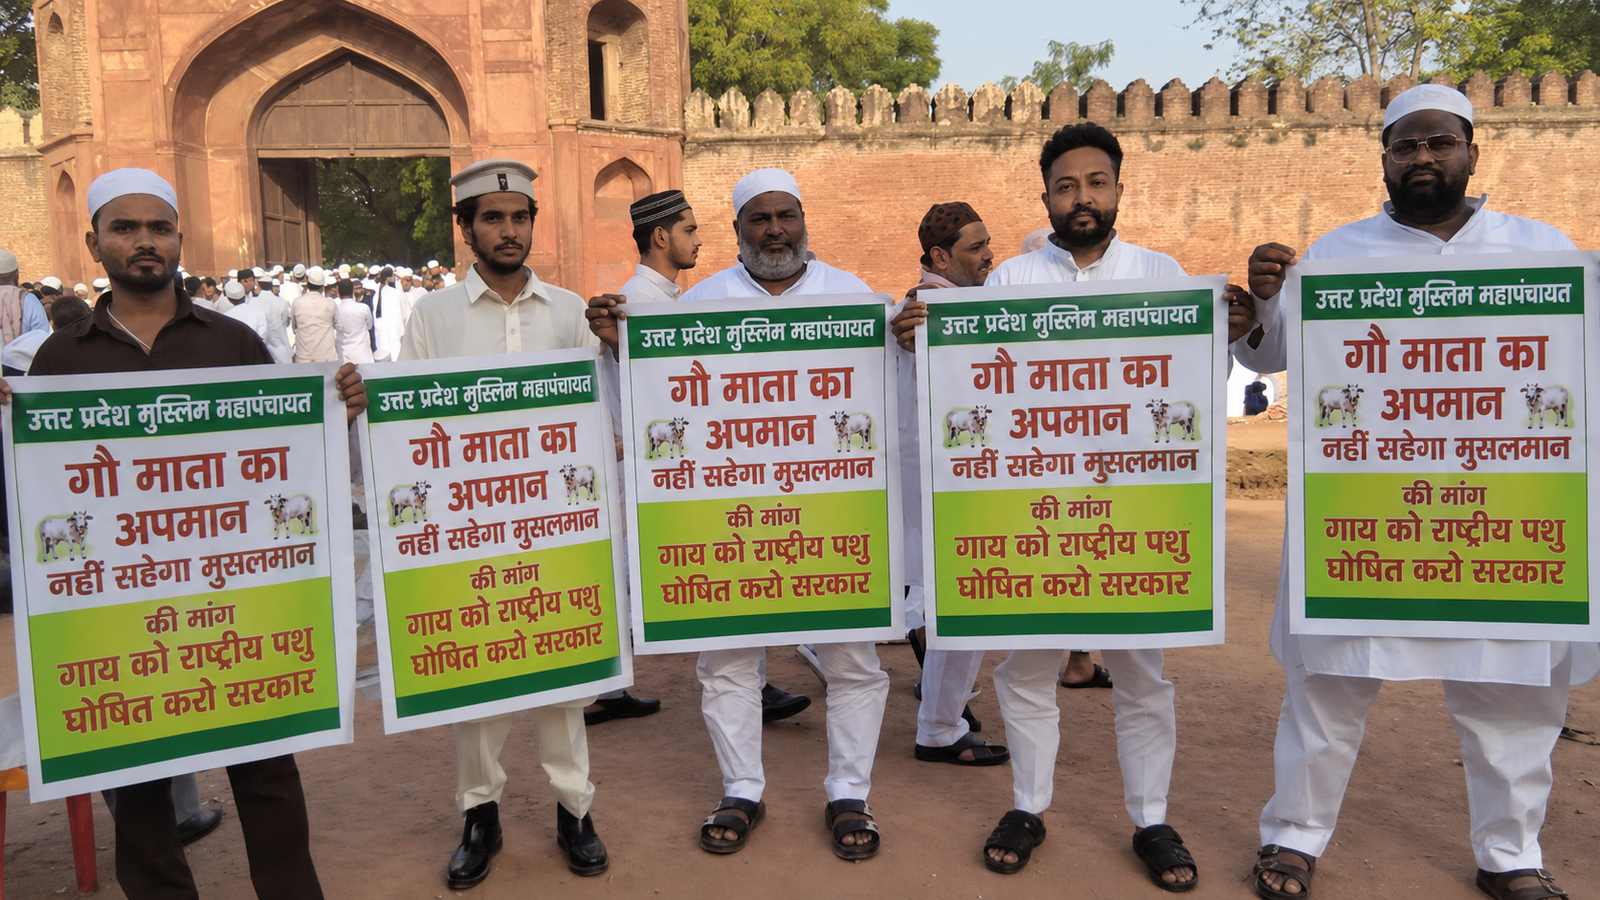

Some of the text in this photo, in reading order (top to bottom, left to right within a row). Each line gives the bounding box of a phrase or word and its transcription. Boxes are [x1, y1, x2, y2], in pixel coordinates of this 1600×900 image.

[1315, 278, 1572, 315] उत्तर प्रदेश मुस्लिम महापंचायत
[640, 315, 875, 351] उत्तर प्रदेश मुस्लिम महापंचायत
[941, 300, 1200, 339] उत्तर प्रदेश मुस्लिम महापंचायत
[1343, 323, 1549, 373] गौ माता का
[668, 360, 855, 407] गौ माता का
[971, 347, 1172, 394] गौ माता का
[26, 389, 312, 434] उत्तर प्रदेश मुस्लिम महापंचायत
[378, 372, 592, 412] उत्तर प्रदेश मुस्लिम महापंचायत
[1380, 386, 1506, 422] अपमान
[705, 415, 817, 450] अपमान
[1009, 403, 1131, 439] अपमान
[409, 421, 578, 469] गौ माता का
[950, 446, 1200, 483] नहीं सहेगा मुसलमान
[1321, 428, 1572, 471] नहीं सहेगा मुसलमान
[65, 444, 290, 498] गौ माता का
[448, 470, 549, 512] अपमान
[651, 457, 875, 493] नहीं सहेगा मुसलमान
[1030, 495, 1113, 520] की मांग
[1401, 479, 1488, 506] की मांग
[115, 501, 249, 547] अपमान
[396, 508, 600, 556] नहीं सहेगा मुसलमान
[725, 502, 802, 528] की मांग
[1323, 510, 1566, 553] गाय को राष्ट्रीय पशु
[657, 530, 871, 567] गाय को राष्ट्रीय पशु
[954, 523, 1191, 564] गाय को राष्ट्रीय पशु
[46, 542, 316, 597] नहीं सहेगा मुसलमान
[470, 560, 540, 590] की मांग
[660, 569, 872, 605] घोषित करो सरकार
[956, 564, 1192, 600] घोषित करो सरकार
[1325, 549, 1566, 585] घोषित करो सरकार
[144, 600, 236, 634] की मांग
[406, 583, 601, 637] गाय को राष्ट्रीय पशु
[56, 627, 314, 688] गाय को राष्ट्रीय पशु
[410, 623, 603, 677] घोषित करो सरकार
[62, 669, 317, 734] घोषित करो सरकार
